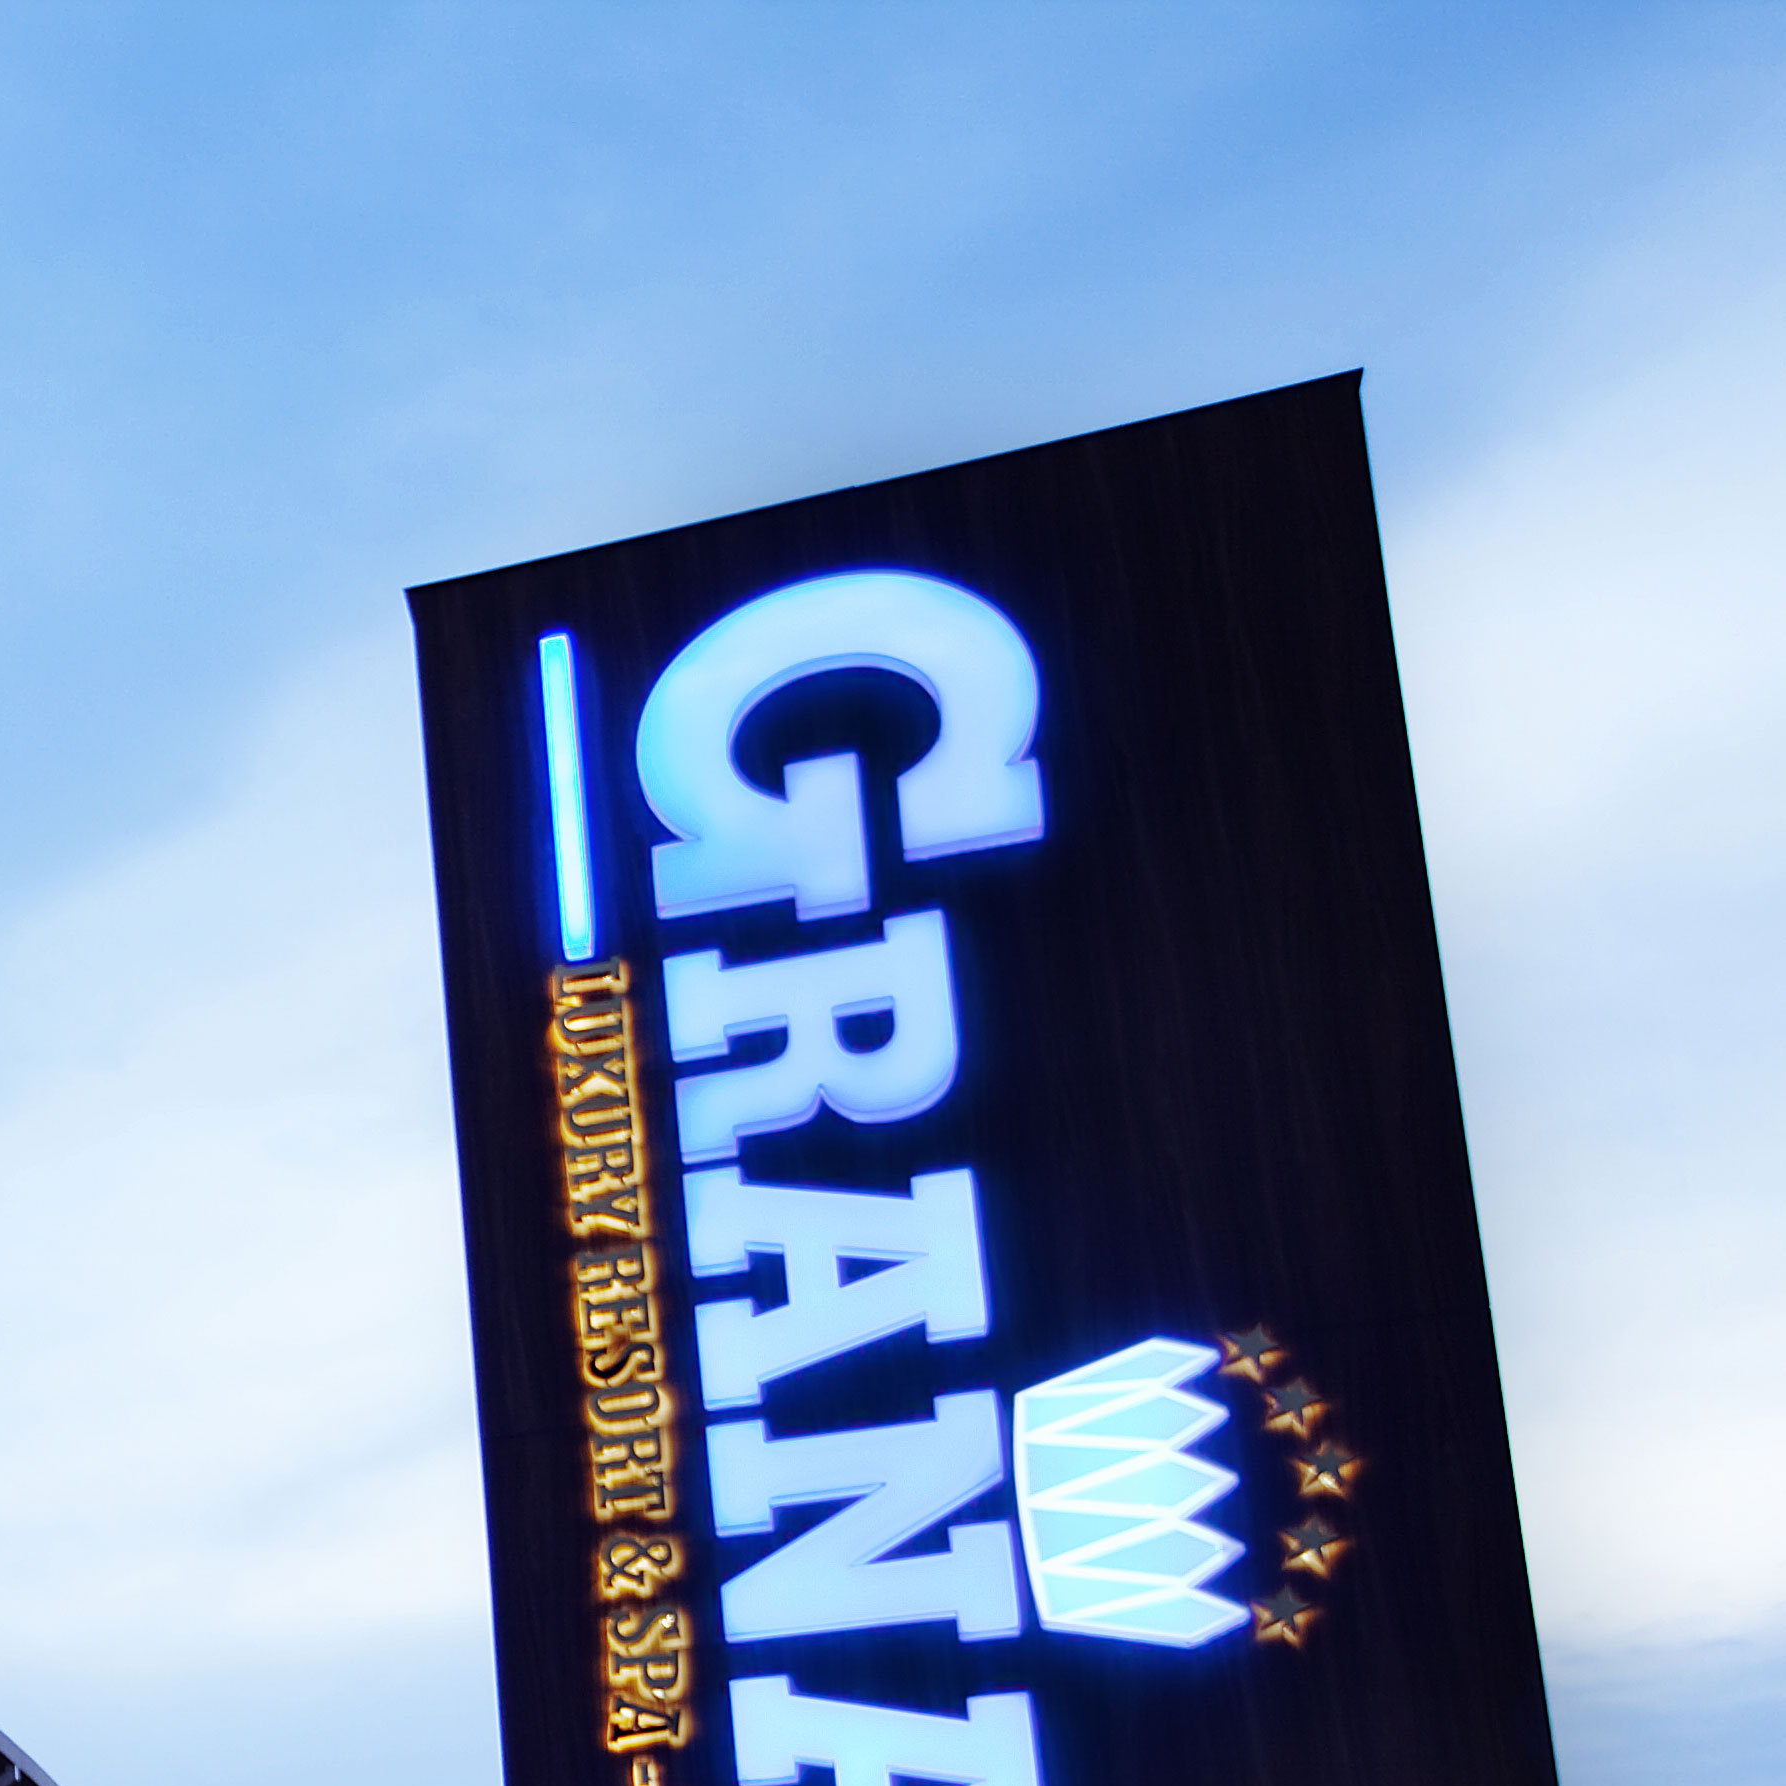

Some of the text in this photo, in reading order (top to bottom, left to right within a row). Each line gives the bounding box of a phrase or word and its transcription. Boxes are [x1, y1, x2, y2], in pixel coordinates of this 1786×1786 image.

[552, 956, 642, 1236] LUXURY
[576, 1242, 670, 1516] RESORT
[601, 1533, 676, 1592] &
[608, 1603, 685, 1748] SPA
